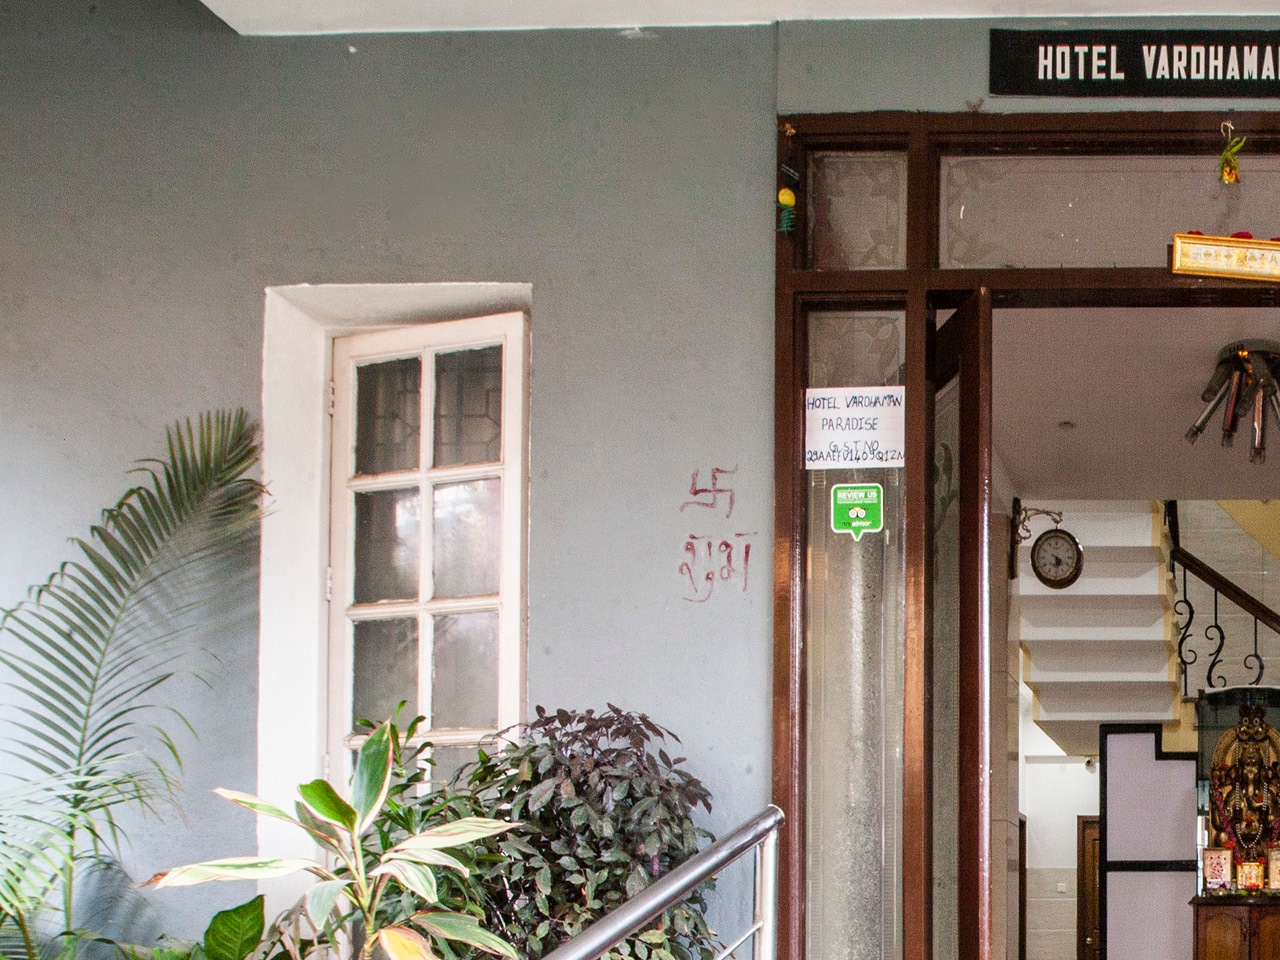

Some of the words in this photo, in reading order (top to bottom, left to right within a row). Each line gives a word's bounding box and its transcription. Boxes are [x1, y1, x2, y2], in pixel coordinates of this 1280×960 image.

[1037, 44, 1125, 80] HOTEL
[807, 396, 840, 410] HOTEL
[845, 394, 902, 408] VARDHAMAN
[822, 417, 879, 431] PARADISE
[837, 491, 865, 499] REVIEW
